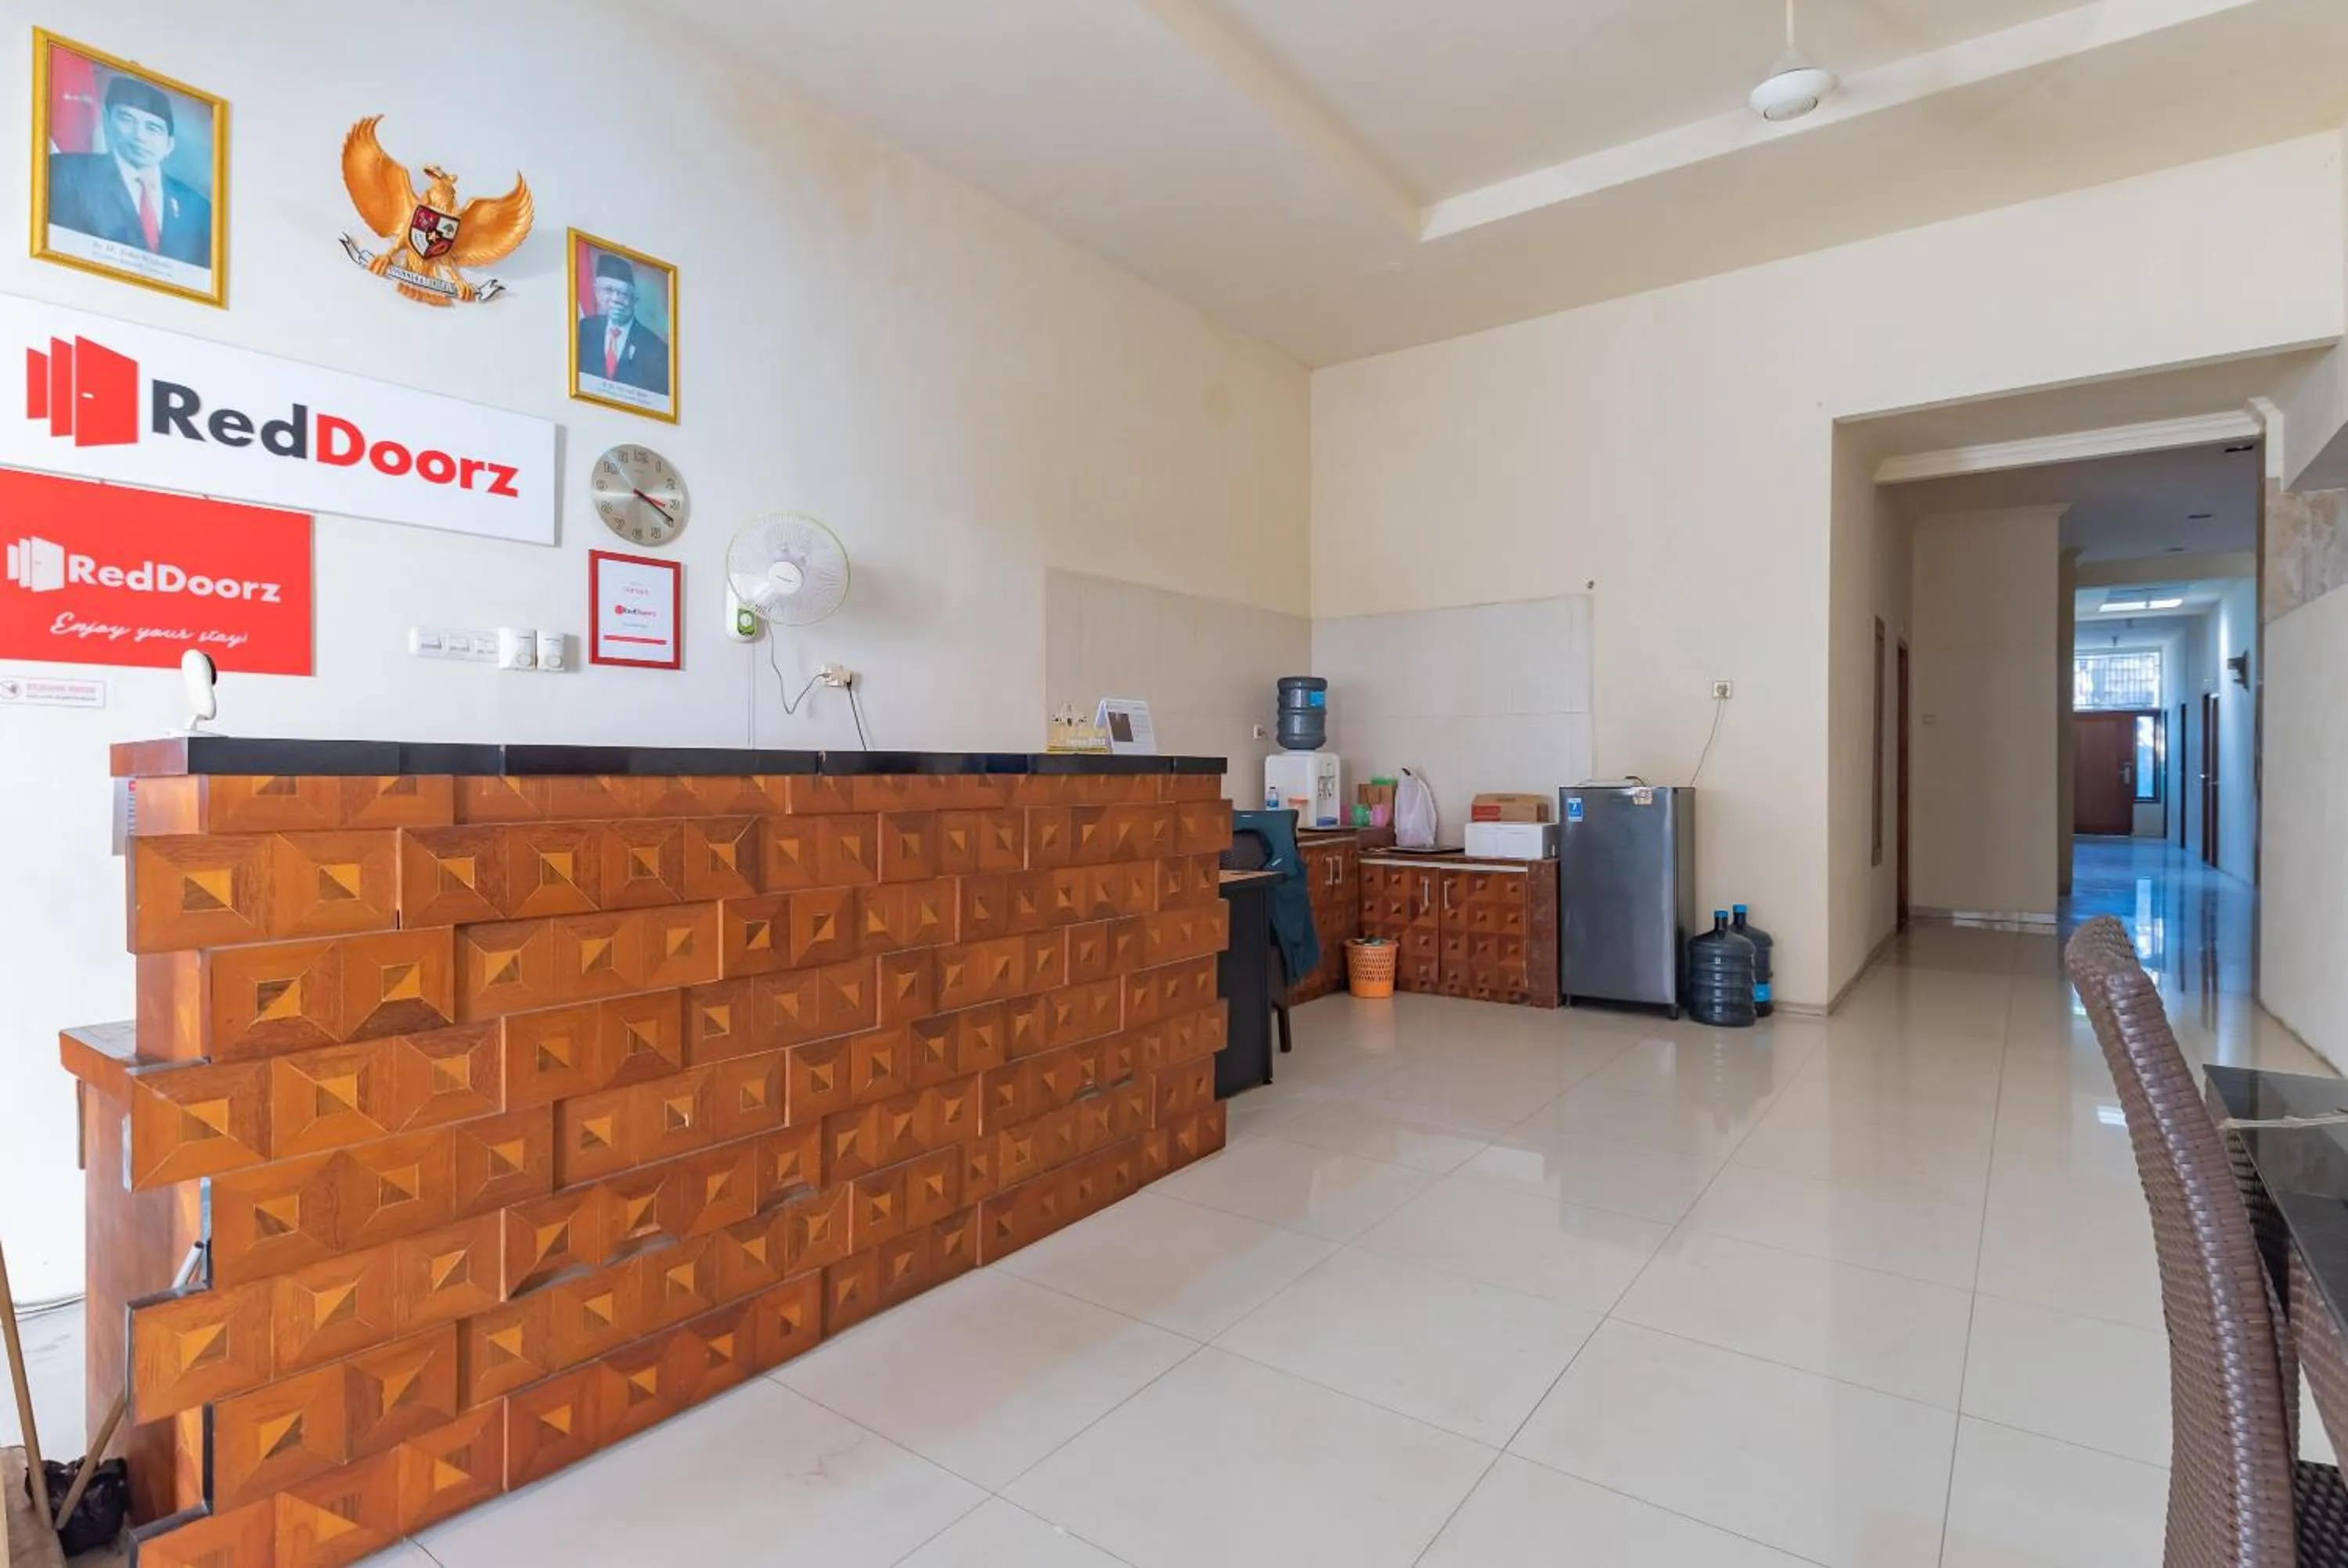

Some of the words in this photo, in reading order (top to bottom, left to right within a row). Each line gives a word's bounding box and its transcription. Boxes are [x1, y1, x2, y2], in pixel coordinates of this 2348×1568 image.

[153, 379, 518, 498] RedDoorz
[633, 449, 650, 463] 12
[69, 554, 281, 602] RedDoorz
[50, 612, 131, 640] Enjoy
[134, 627, 194, 642] your
